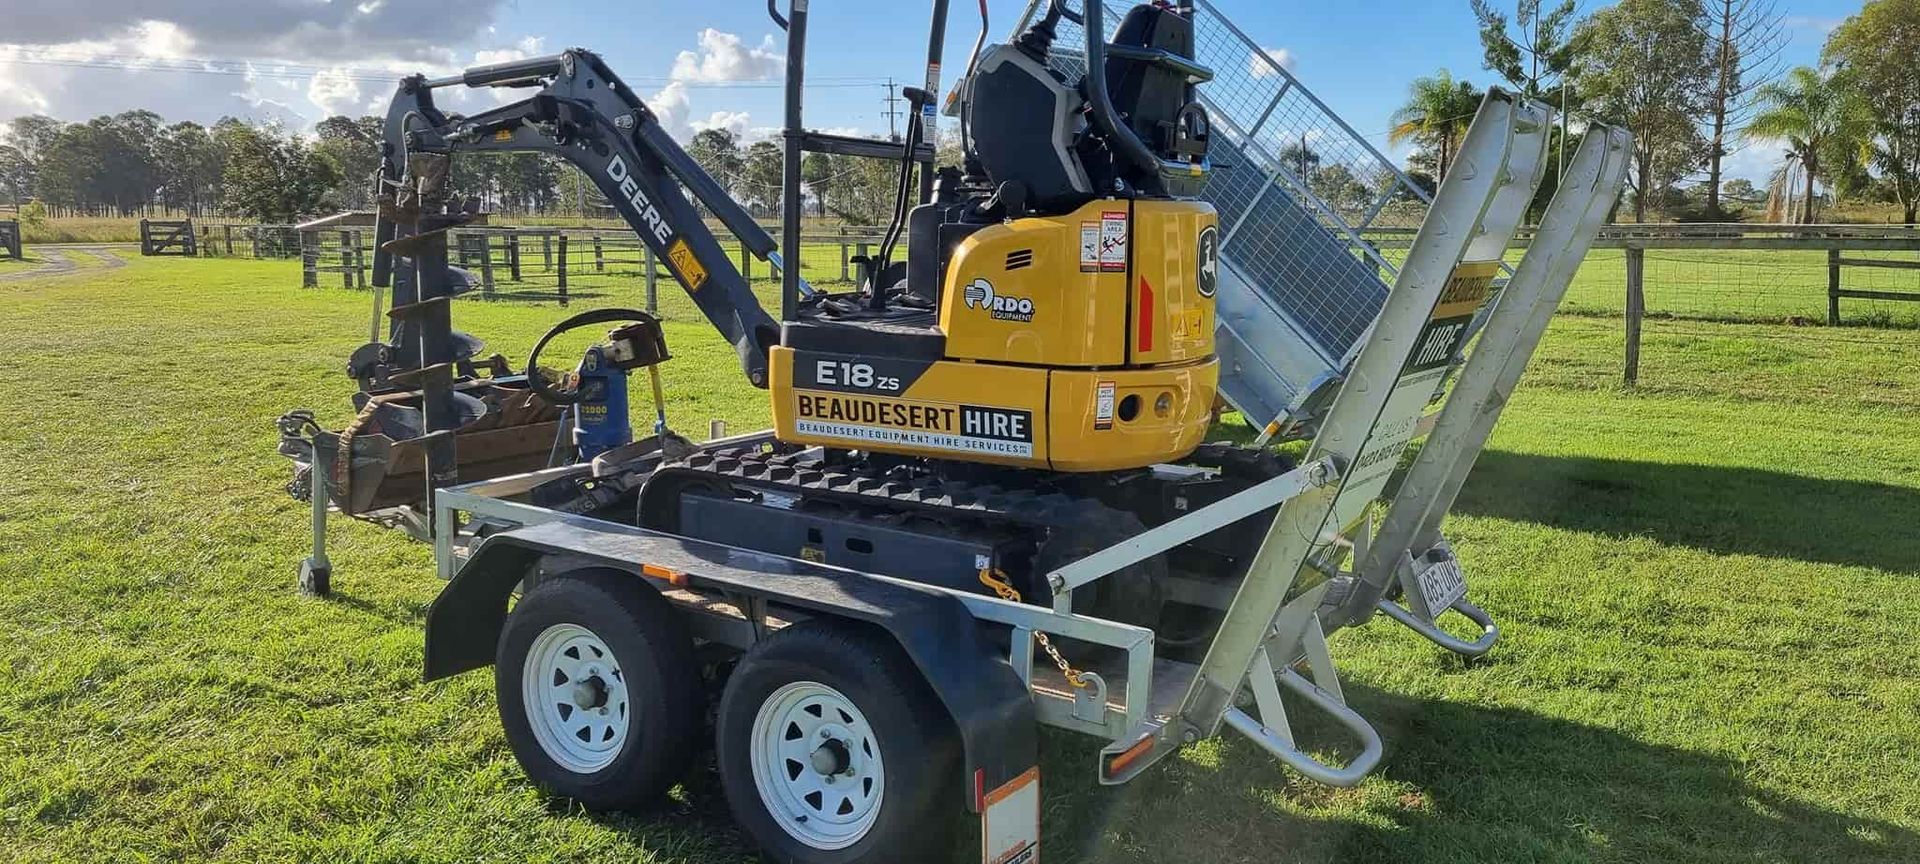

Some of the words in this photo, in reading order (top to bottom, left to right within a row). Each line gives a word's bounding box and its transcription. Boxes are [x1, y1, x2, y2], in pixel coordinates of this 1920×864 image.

[606, 154, 673, 245] DEERE
[992, 311, 1032, 321] EQUIPMENT
[1414, 323, 1464, 366] HIRE
[817, 360, 874, 388] E18
[798, 395, 954, 431] BEAUDESERT
[965, 410, 1026, 438] HIRE
[800, 423, 864, 437] BEAUDESERT
[868, 429, 929, 443] EQUIPMENT
[934, 437, 959, 447] HIRE
[965, 441, 1018, 454] SERVICES
